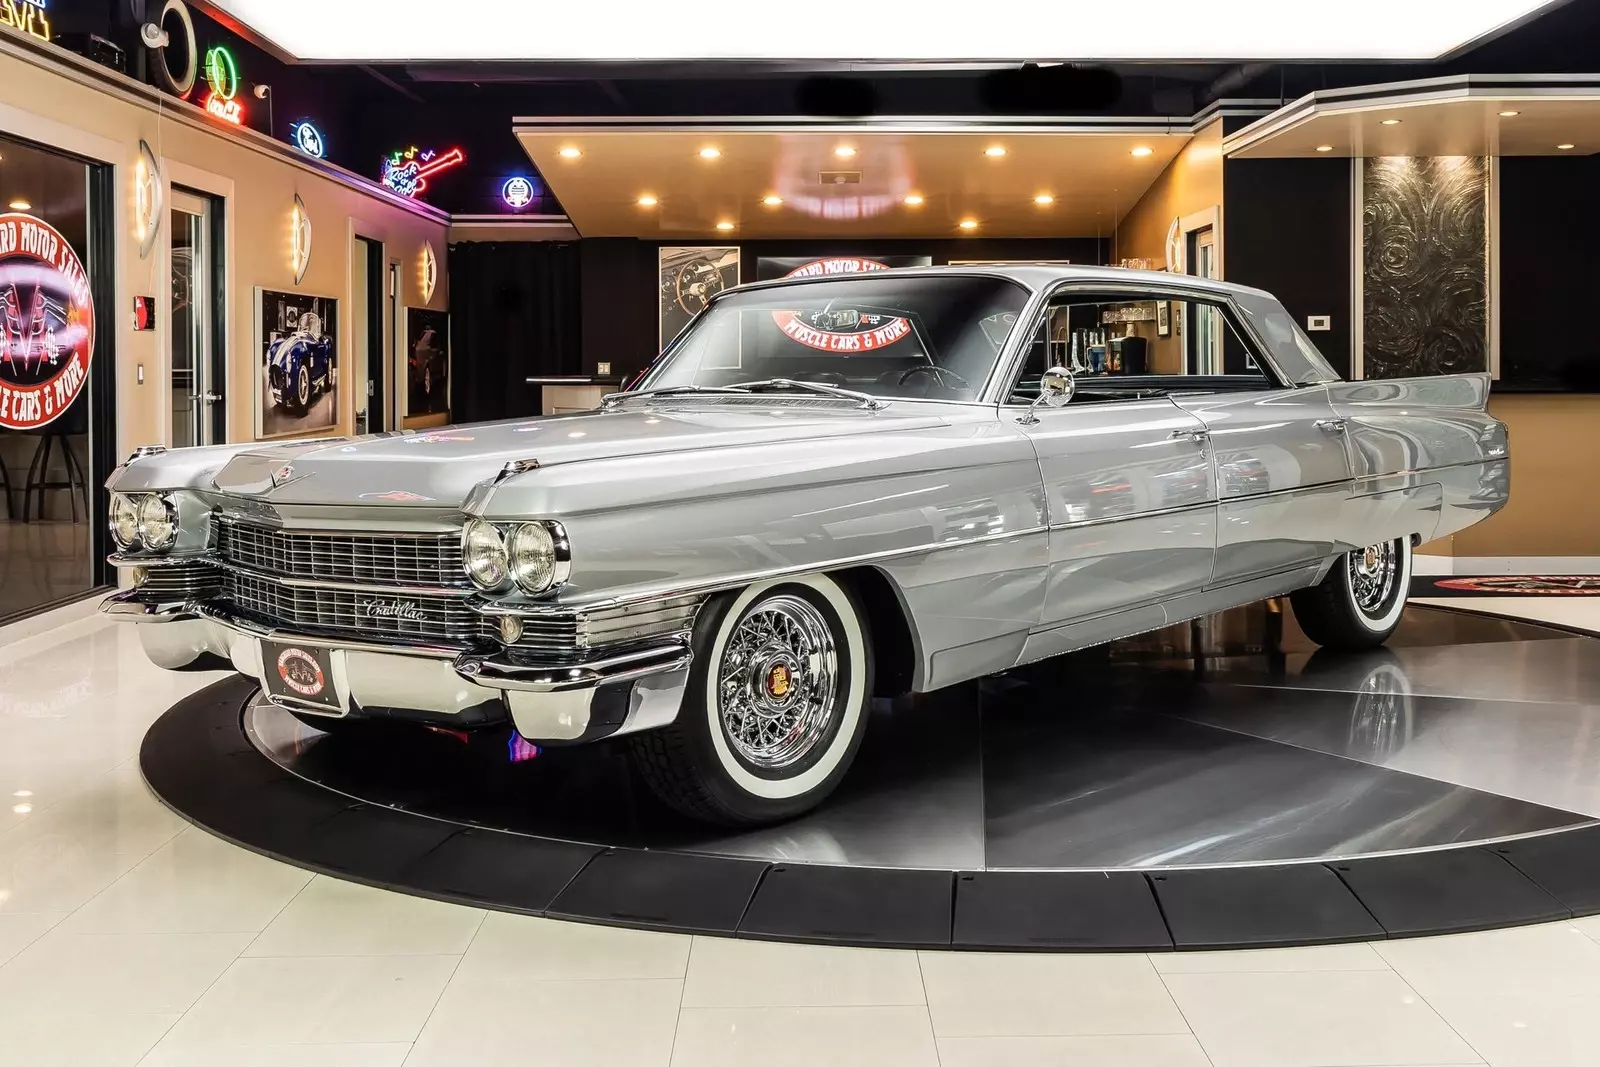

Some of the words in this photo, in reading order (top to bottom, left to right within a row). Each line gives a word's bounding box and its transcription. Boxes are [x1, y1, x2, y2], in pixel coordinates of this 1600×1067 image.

[387, 163, 417, 182] Rock
[20, 221, 58, 264] MOTOR
[58, 245, 89, 306] SALES
[824, 260, 860, 274] MOTOR
[784, 319, 830, 348] MUSCLE
[831, 335, 860, 350] CARS
[864, 333, 873, 348] &
[874, 320, 907, 344] MORE
[12, 389, 41, 421] CARS
[43, 384, 53, 415] &
[54, 351, 84, 409] MORE
[363, 599, 428, 620] Cadillac
